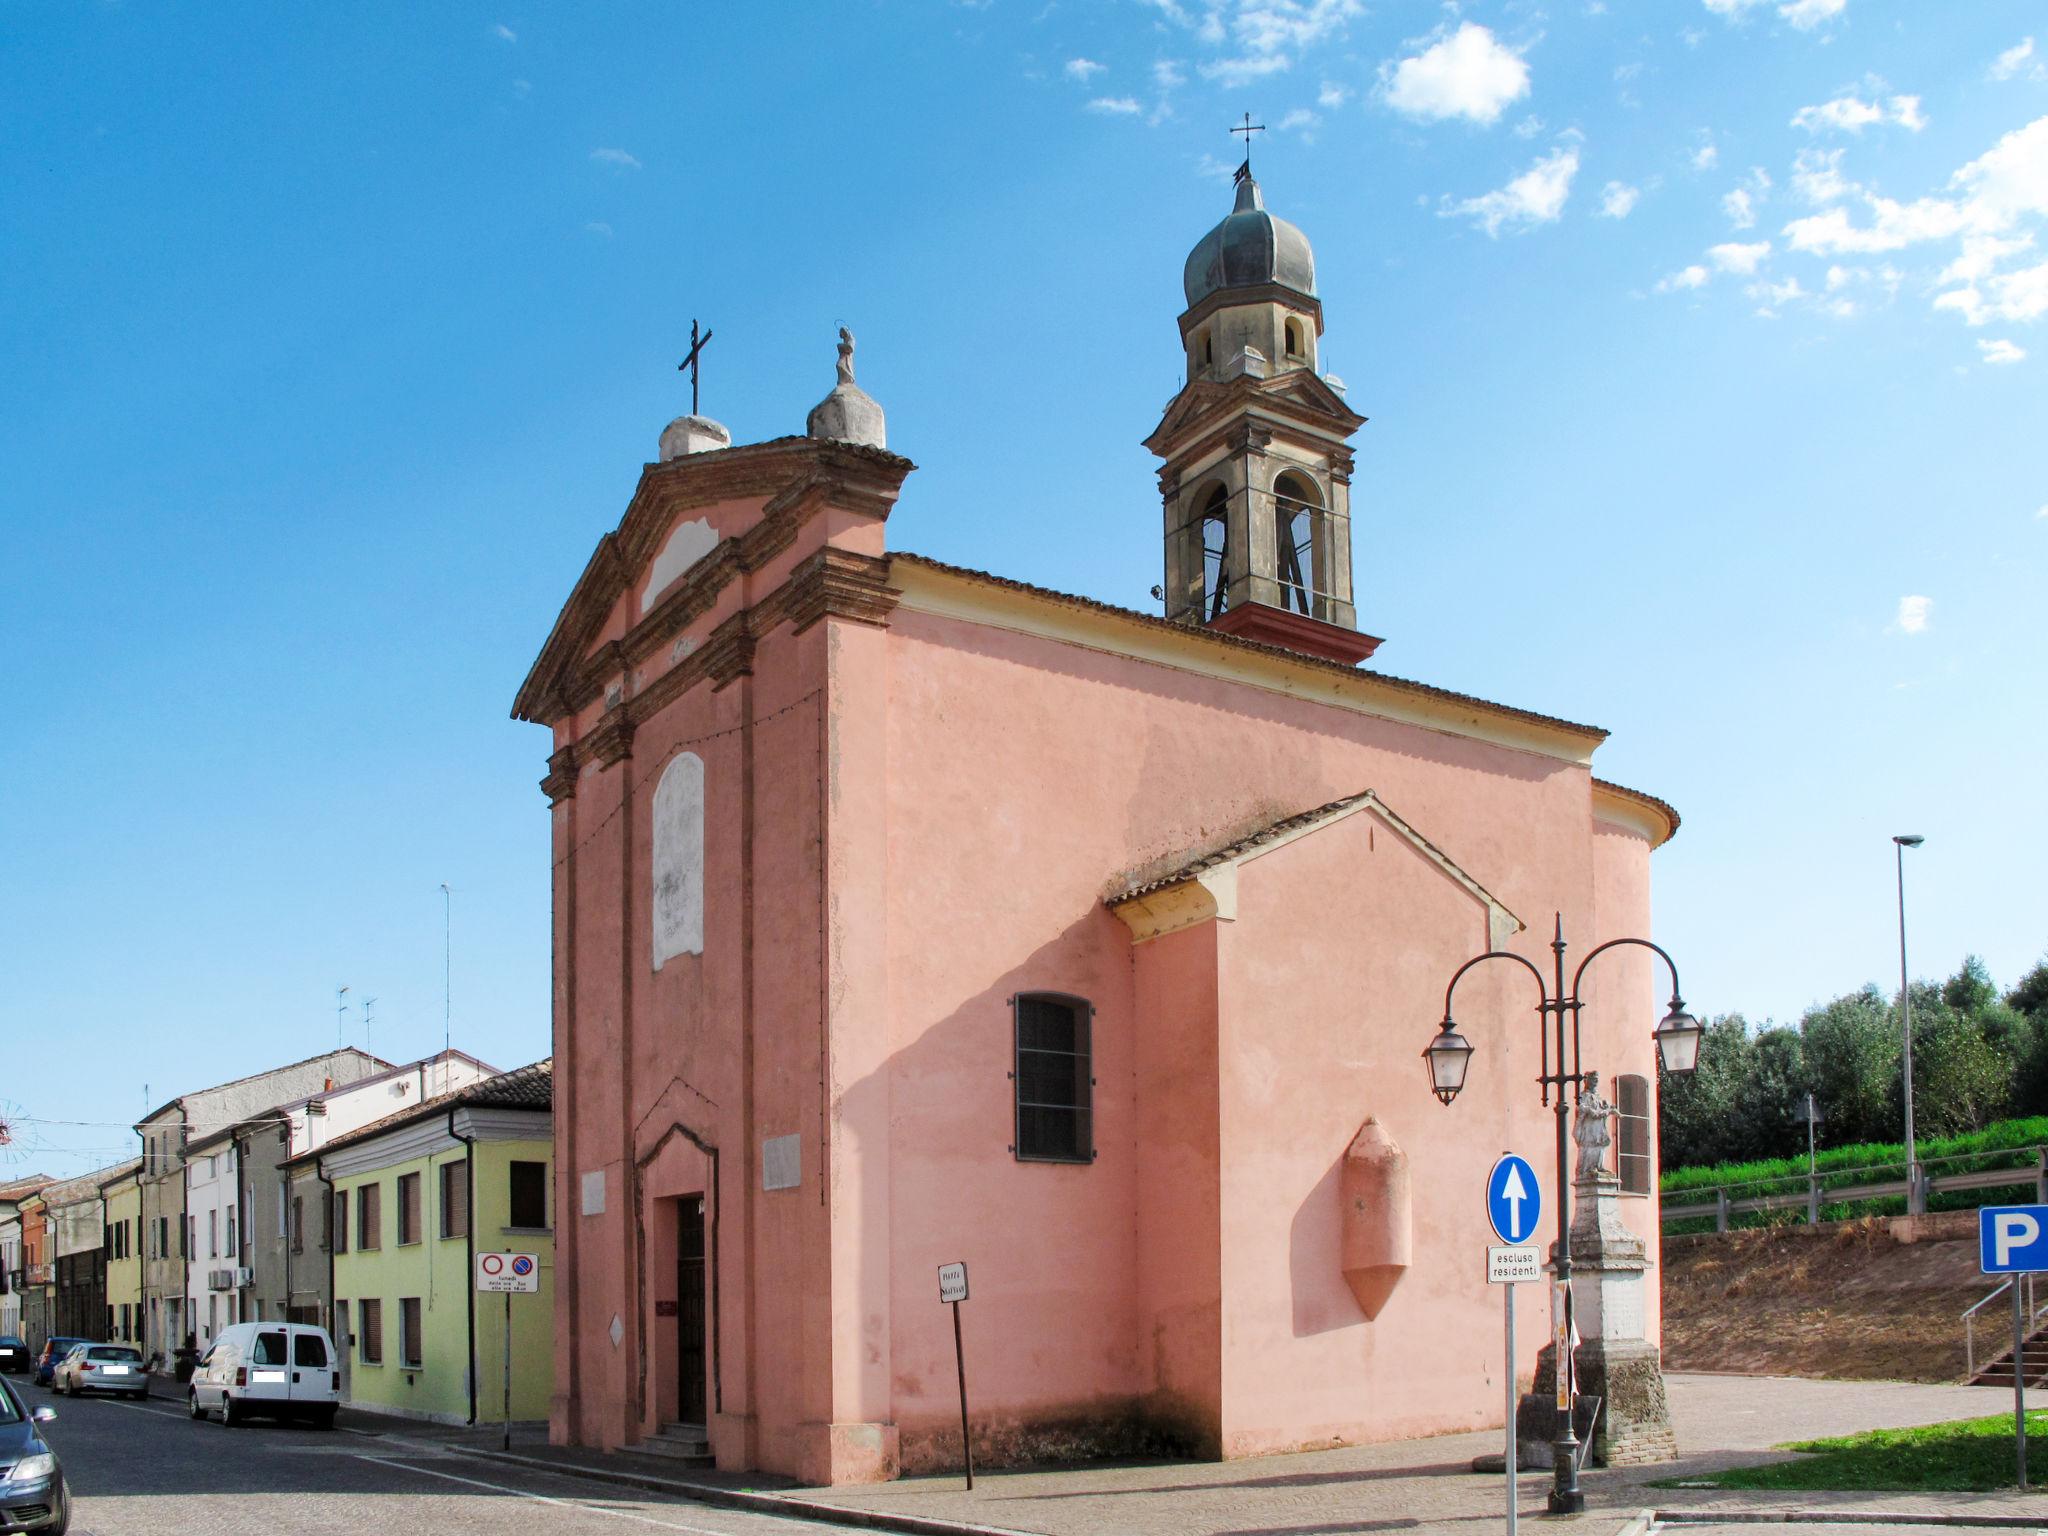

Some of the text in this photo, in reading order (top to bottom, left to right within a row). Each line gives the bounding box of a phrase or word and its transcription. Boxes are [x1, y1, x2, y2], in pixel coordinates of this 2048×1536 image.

[1994, 1213, 2040, 1266] P
[1497, 1253, 1533, 1263] escluso
[1493, 1266, 1537, 1276] residenti
